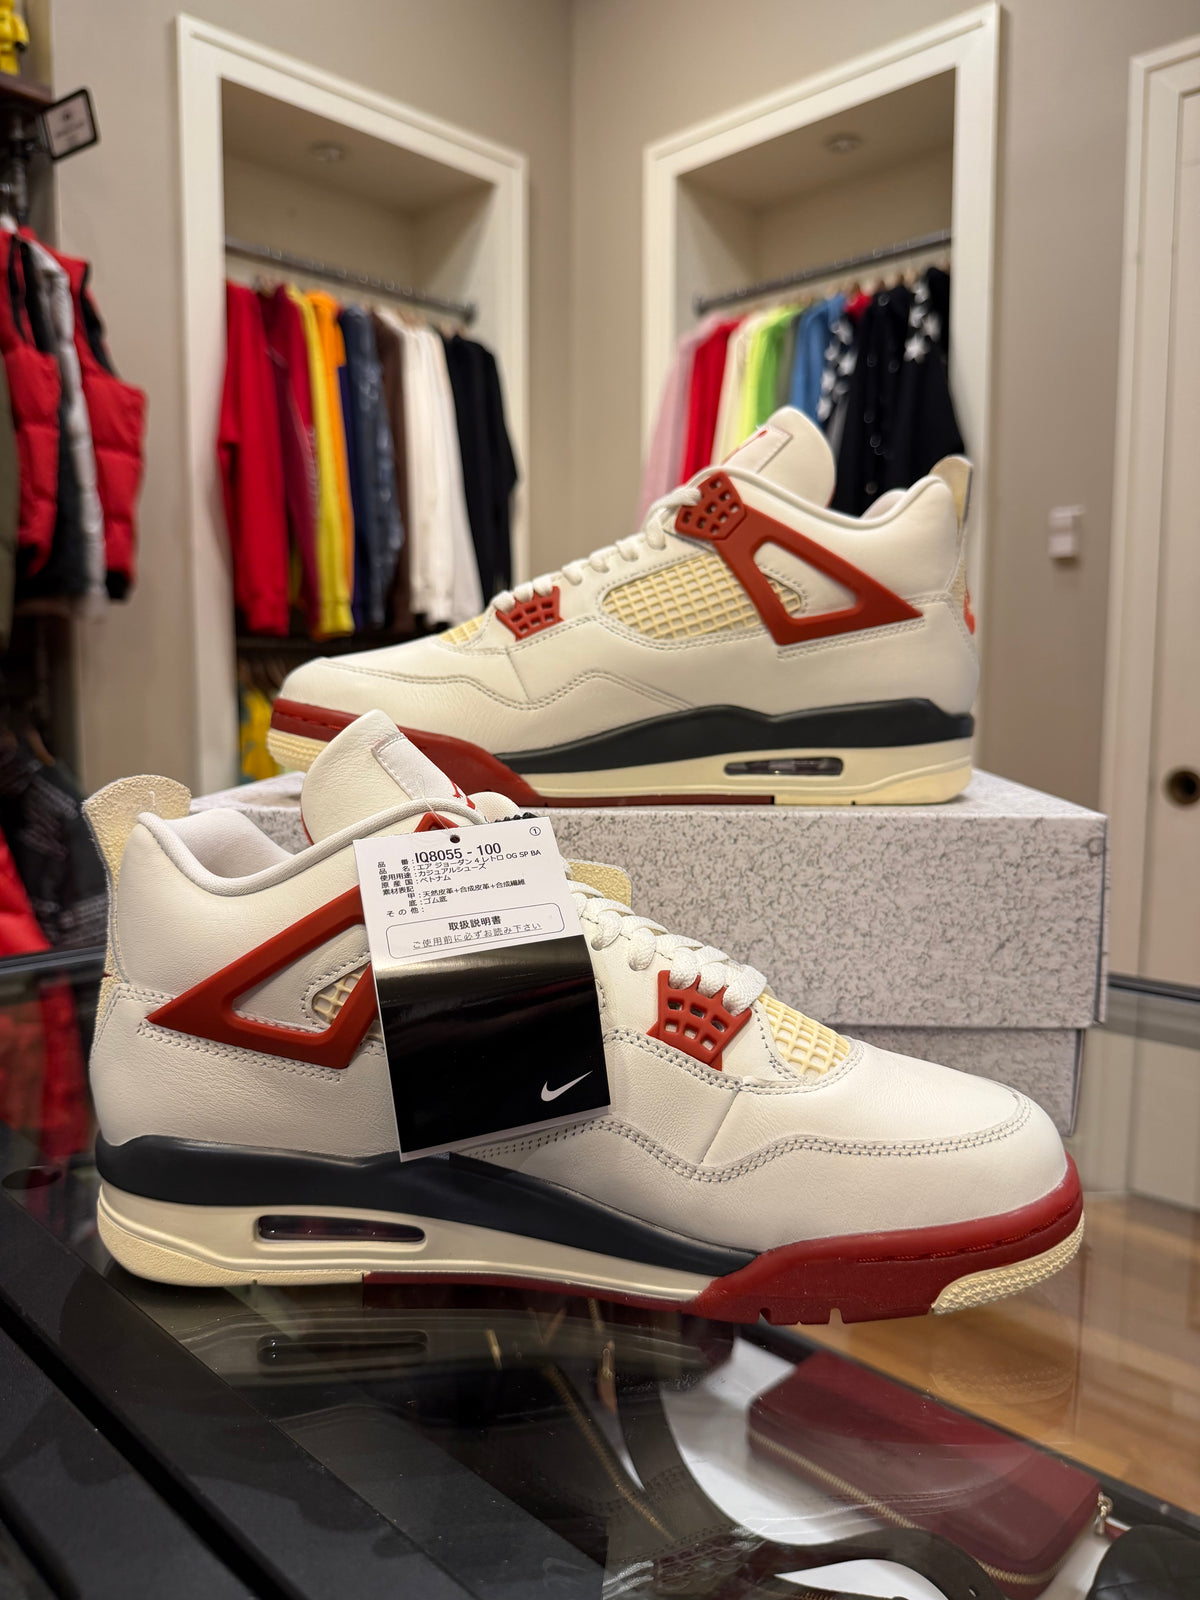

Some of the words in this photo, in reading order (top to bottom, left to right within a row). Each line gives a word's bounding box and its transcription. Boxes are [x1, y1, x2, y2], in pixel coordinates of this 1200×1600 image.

[415, 848, 463, 863] IQ8055
[477, 842, 502, 856] 100
[482, 854, 504, 863] レトロ
[506, 852, 518, 860] OG
[519, 850, 529, 858] SP
[530, 849, 541, 857] BA
[448, 915, 502, 931] 取扱説明書
[412, 922, 542, 949] ご使用前に必ずお読み下さい
